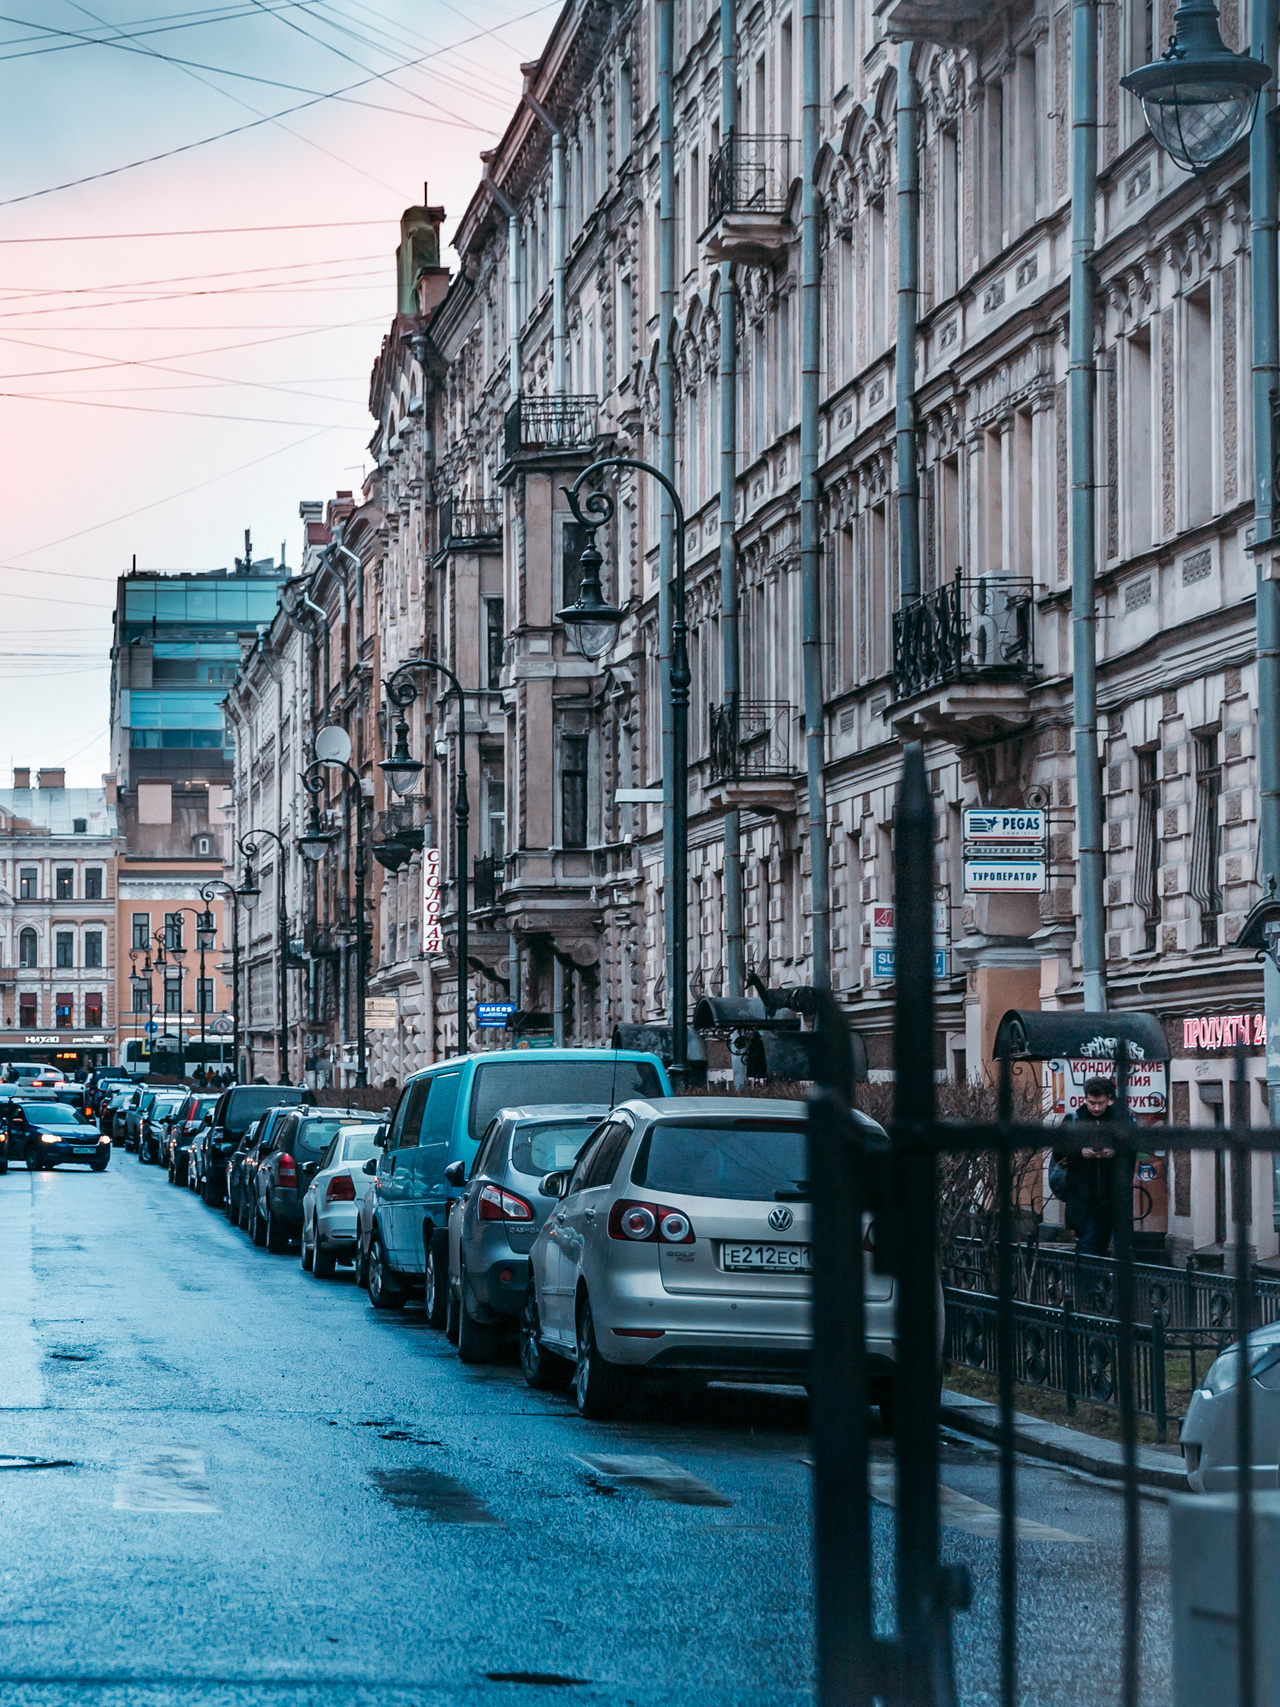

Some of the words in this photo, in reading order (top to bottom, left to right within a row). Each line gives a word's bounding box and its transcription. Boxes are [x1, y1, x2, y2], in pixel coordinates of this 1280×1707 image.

[1002, 817, 1040, 830] PEGAS
[972, 872, 1038, 881] ТУРОПЕРАТОР
[425, 850, 440, 952] СТОЛОВАЯ
[1183, 1015, 1251, 1051] ПРОДУКТЫ
[1073, 1061, 1163, 1074] КОНДИСКИЕ
